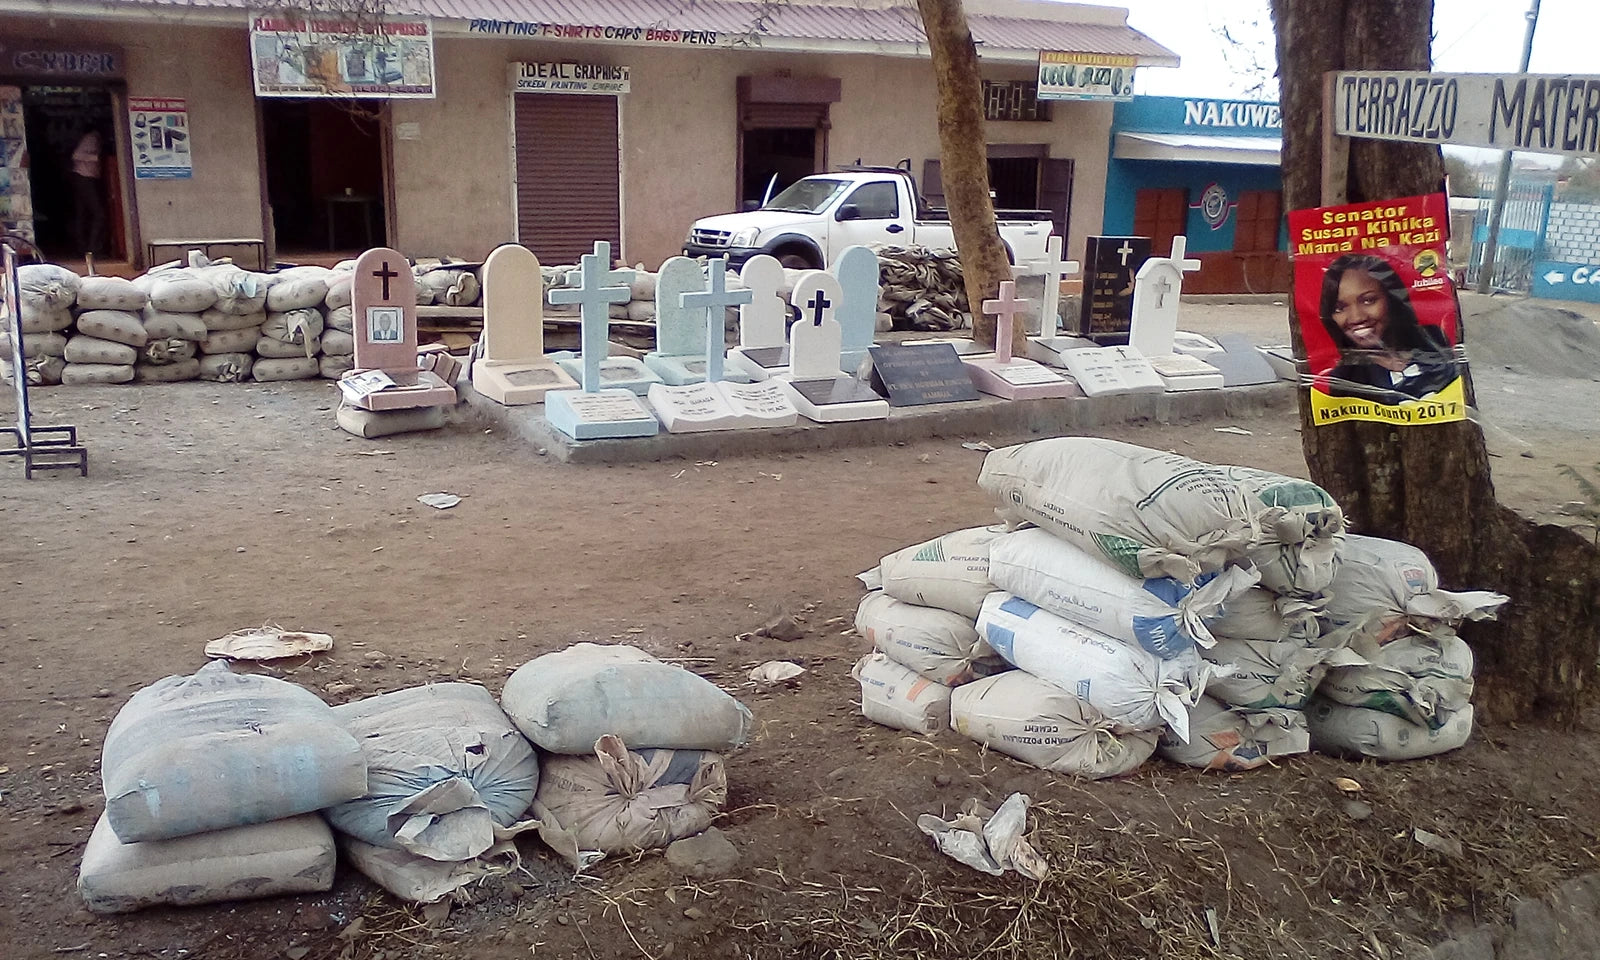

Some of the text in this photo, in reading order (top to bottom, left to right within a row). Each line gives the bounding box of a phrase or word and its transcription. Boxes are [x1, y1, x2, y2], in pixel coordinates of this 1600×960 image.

[469, 19, 717, 45] PRINTING T-SHIRTS CAPS BAGS PENS
[518, 79, 547, 88] SCREEN
[551, 81, 588, 90] PRINTING
[1184, 100, 1283, 129] NAKUWE
[1342, 76, 1459, 139] TERRAZZO
[1323, 206, 1408, 225] Senator
[1302, 217, 1435, 241] Susan Kihika
[1298, 229, 1441, 255] Mama Na Kazi
[1320, 402, 1457, 422] Nakuru County 2017
[1023, 724, 1059, 733] CEMENT
